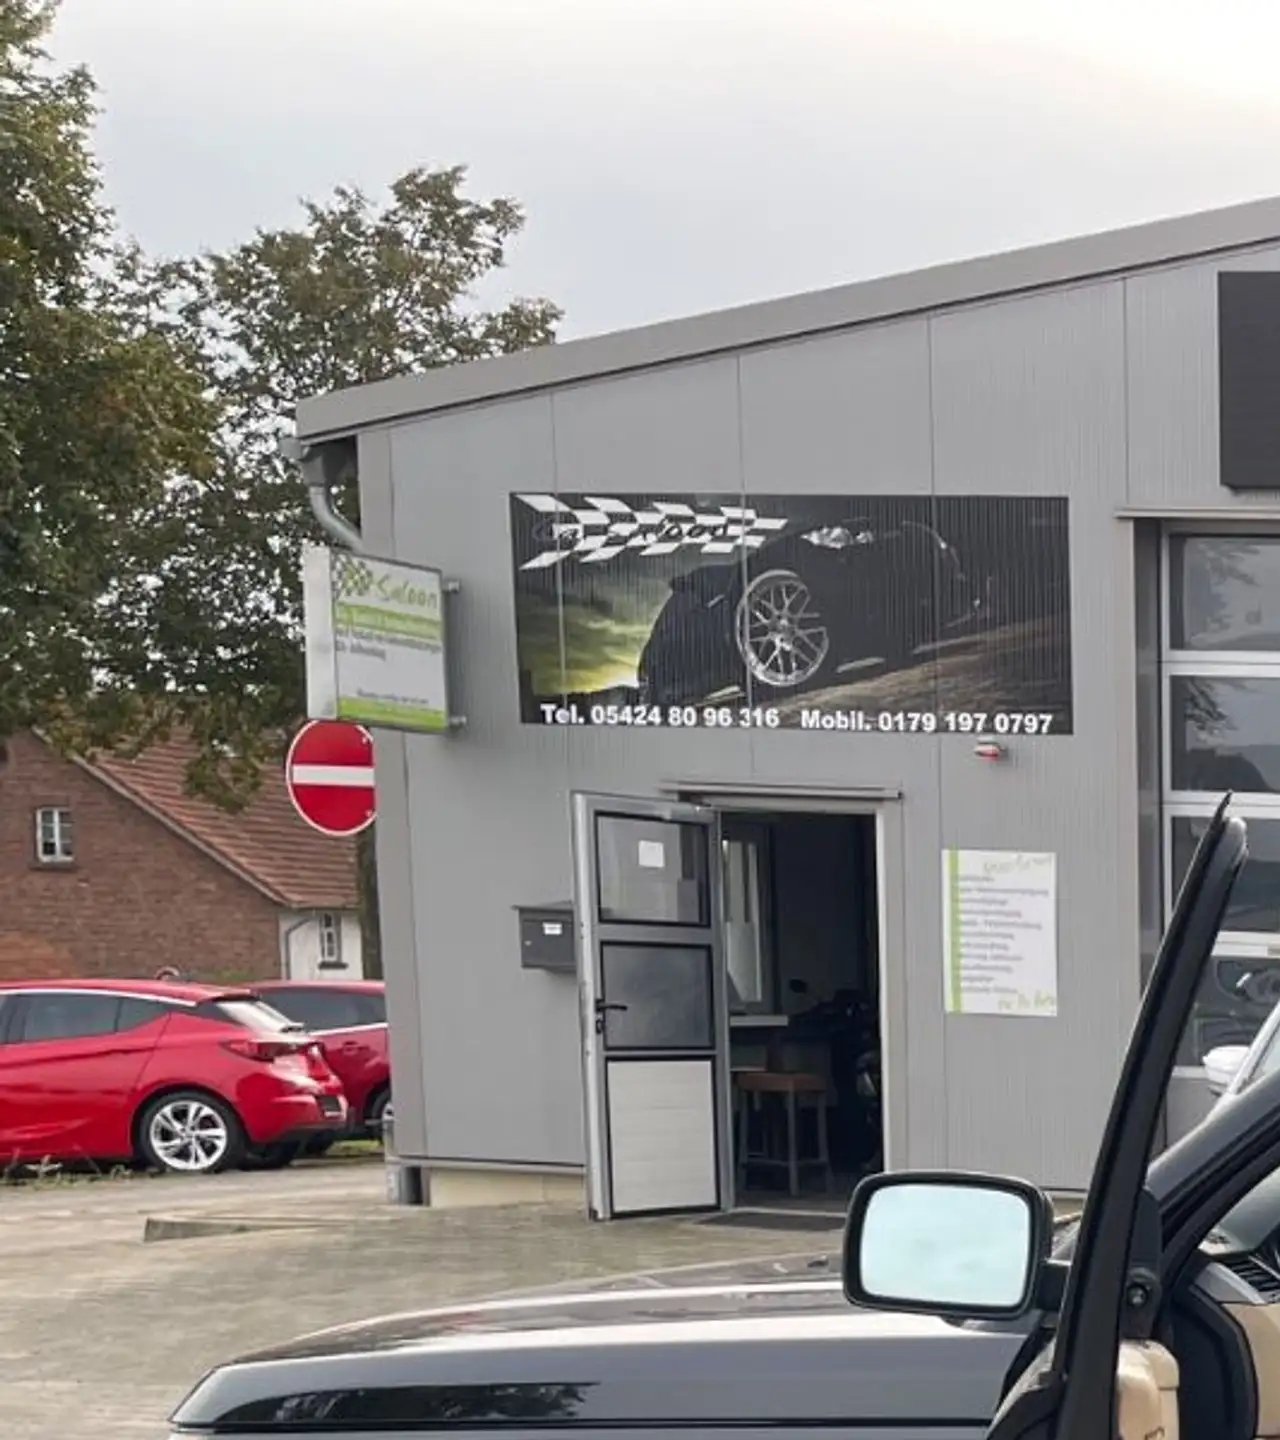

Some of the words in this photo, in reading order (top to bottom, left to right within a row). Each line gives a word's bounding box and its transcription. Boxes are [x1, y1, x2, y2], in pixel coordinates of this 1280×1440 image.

[540, 704, 585, 725] Tel.
[591, 705, 661, 725] 05424
[668, 706, 698, 726] 80
[704, 707, 733, 727] 96
[739, 708, 780, 728] 316
[801, 709, 871, 731] Mobil.
[877, 711, 936, 732] 0179
[944, 712, 987, 733] 197
[994, 713, 1053, 734] 0797
